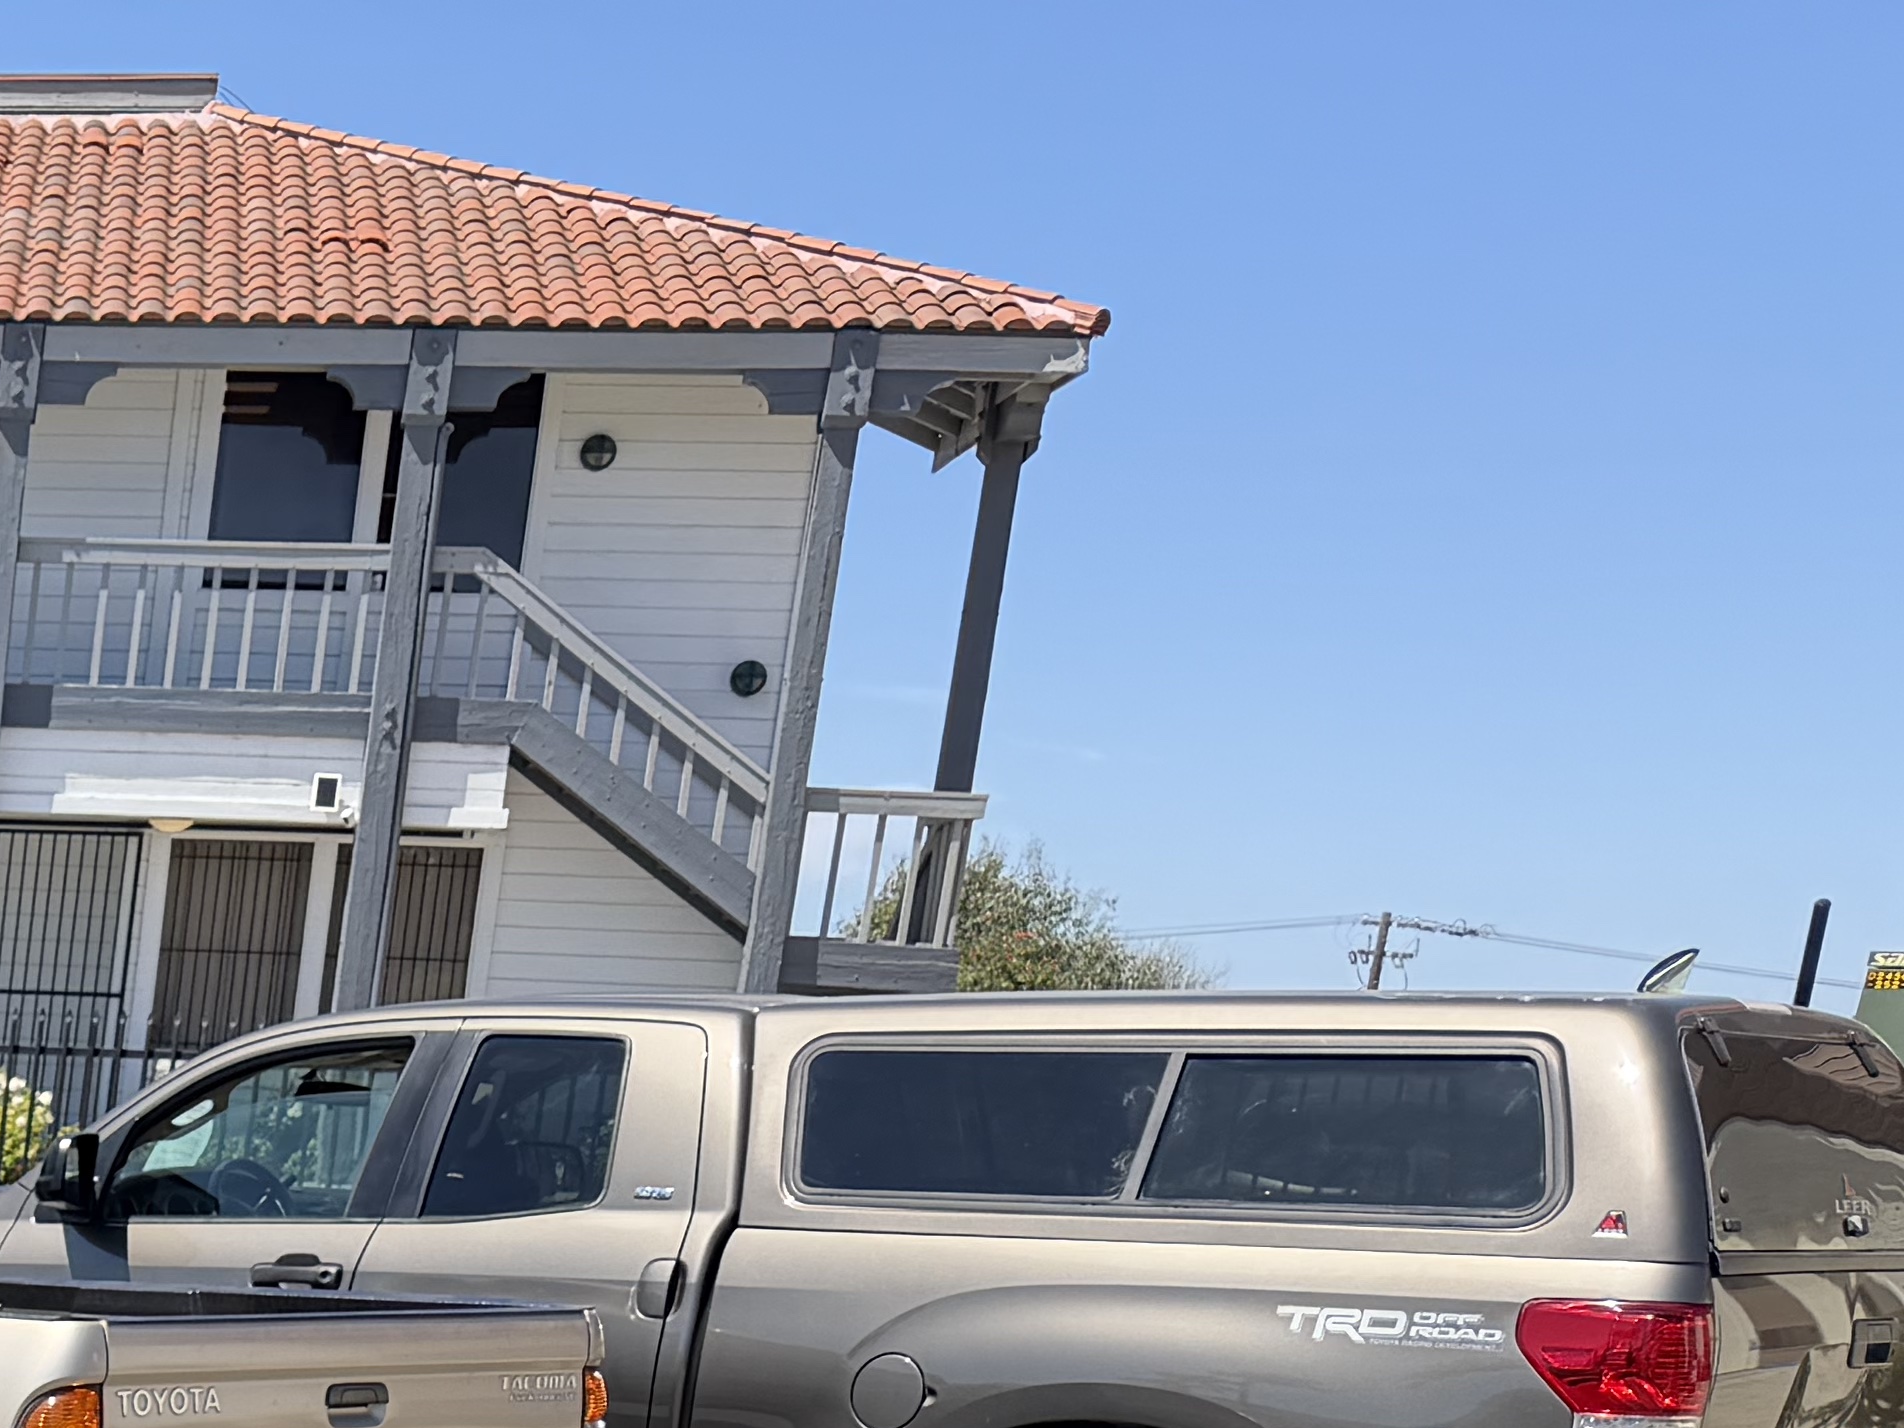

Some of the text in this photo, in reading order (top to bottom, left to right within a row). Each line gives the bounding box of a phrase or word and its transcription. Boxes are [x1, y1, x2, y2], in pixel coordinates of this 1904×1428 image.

[1835, 1199, 1871, 1215] LEER
[1276, 1305, 1408, 1344] TRD
[1409, 1326, 1505, 1342] ROAD
[116, 1386, 221, 1418] TOYOTA
